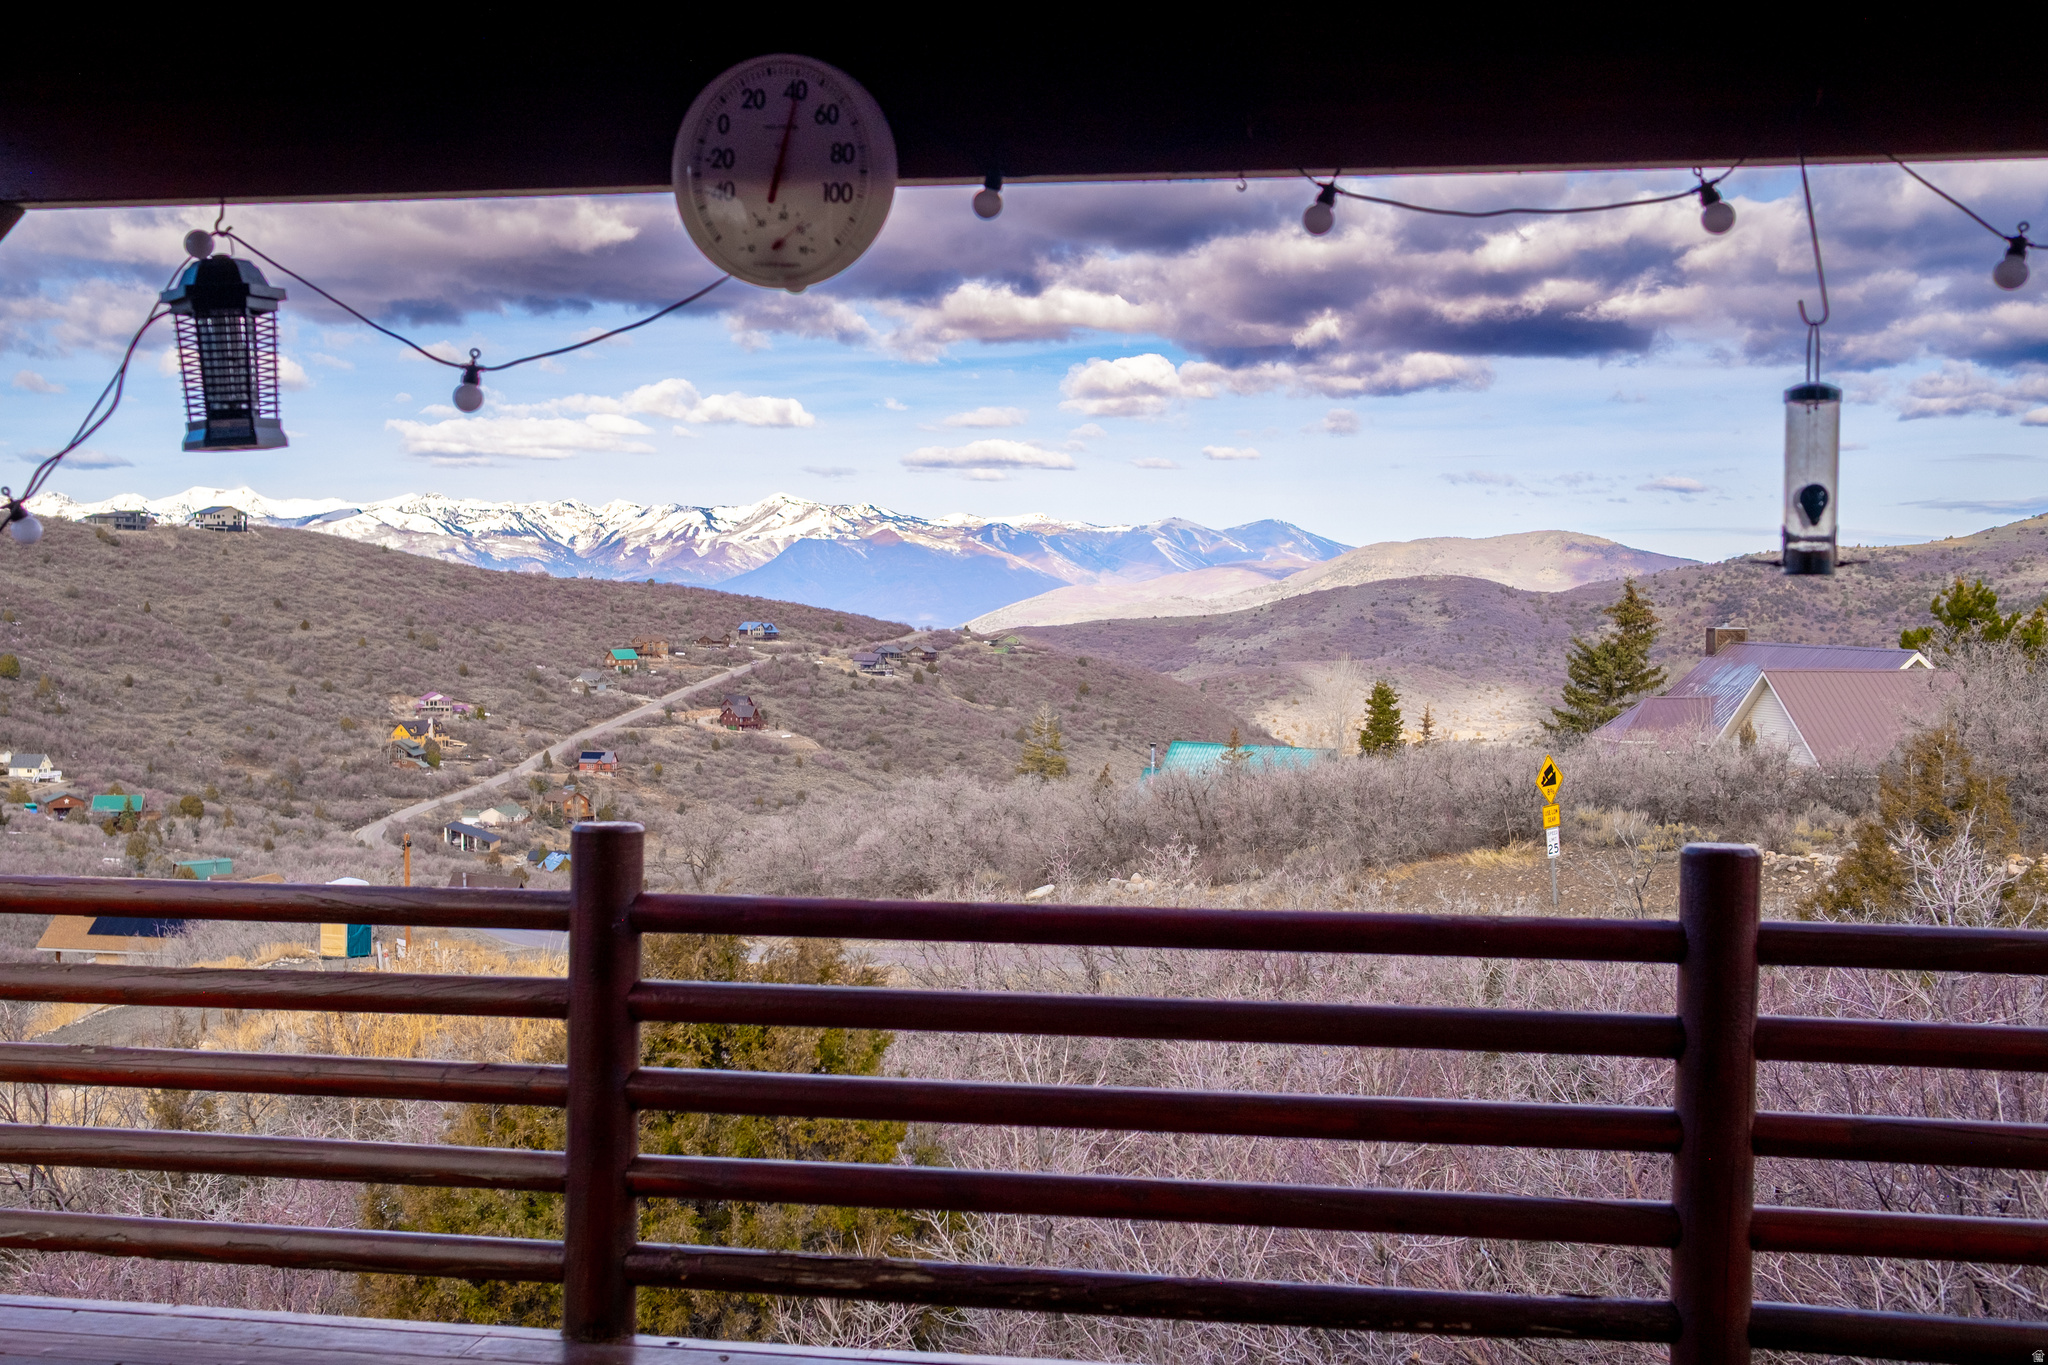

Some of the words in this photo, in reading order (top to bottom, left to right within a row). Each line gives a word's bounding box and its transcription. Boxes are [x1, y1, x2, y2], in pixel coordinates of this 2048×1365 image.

[741, 88, 766, 110] 20
[783, 79, 808, 101] 40
[717, 113, 730, 135] 0
[814, 103, 839, 125] 60
[830, 142, 856, 165] 80
[823, 181, 853, 204] 100
[1548, 843, 1559, 855] 25
